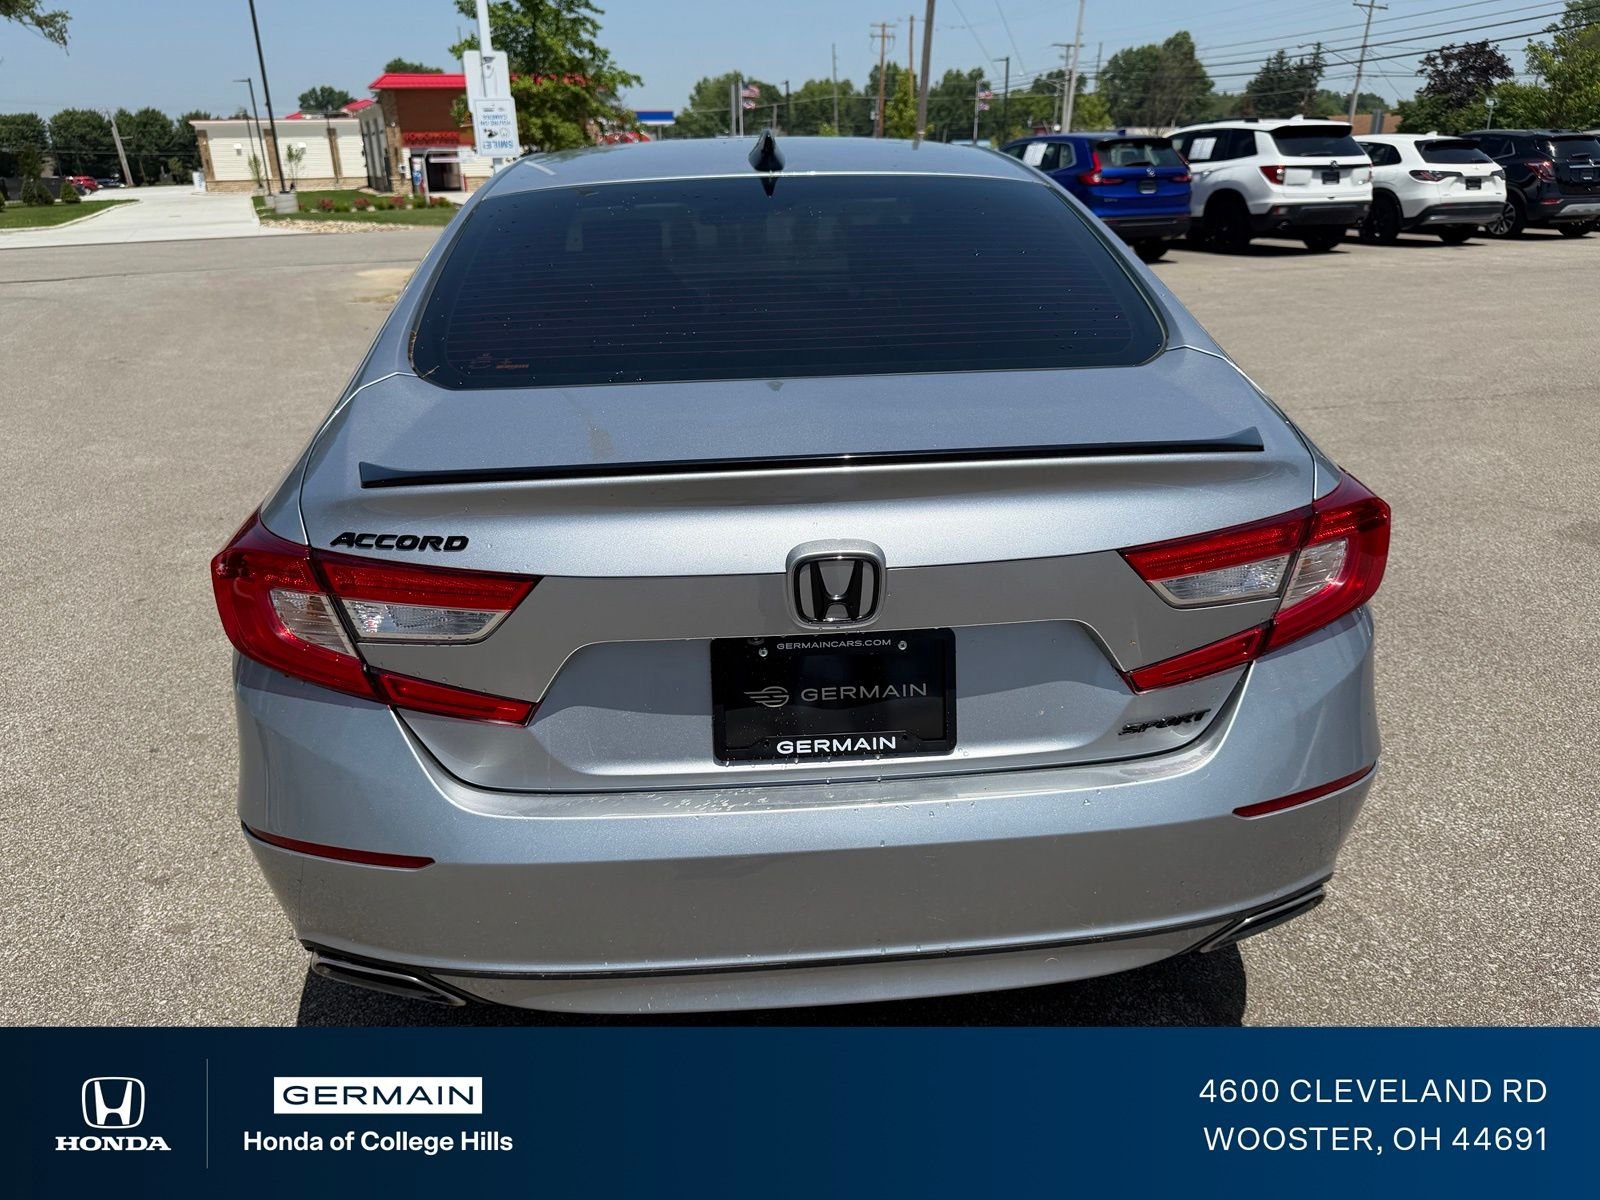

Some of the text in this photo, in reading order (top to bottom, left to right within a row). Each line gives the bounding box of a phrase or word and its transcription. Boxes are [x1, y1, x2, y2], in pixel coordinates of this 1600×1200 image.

[330, 532, 469, 552] ACCORD
[776, 639, 892, 650] GERMAINCARS.COM
[801, 683, 928, 702] GERMAIN
[1117, 708, 1211, 735] SPORT
[776, 736, 897, 755] GERMAIN
